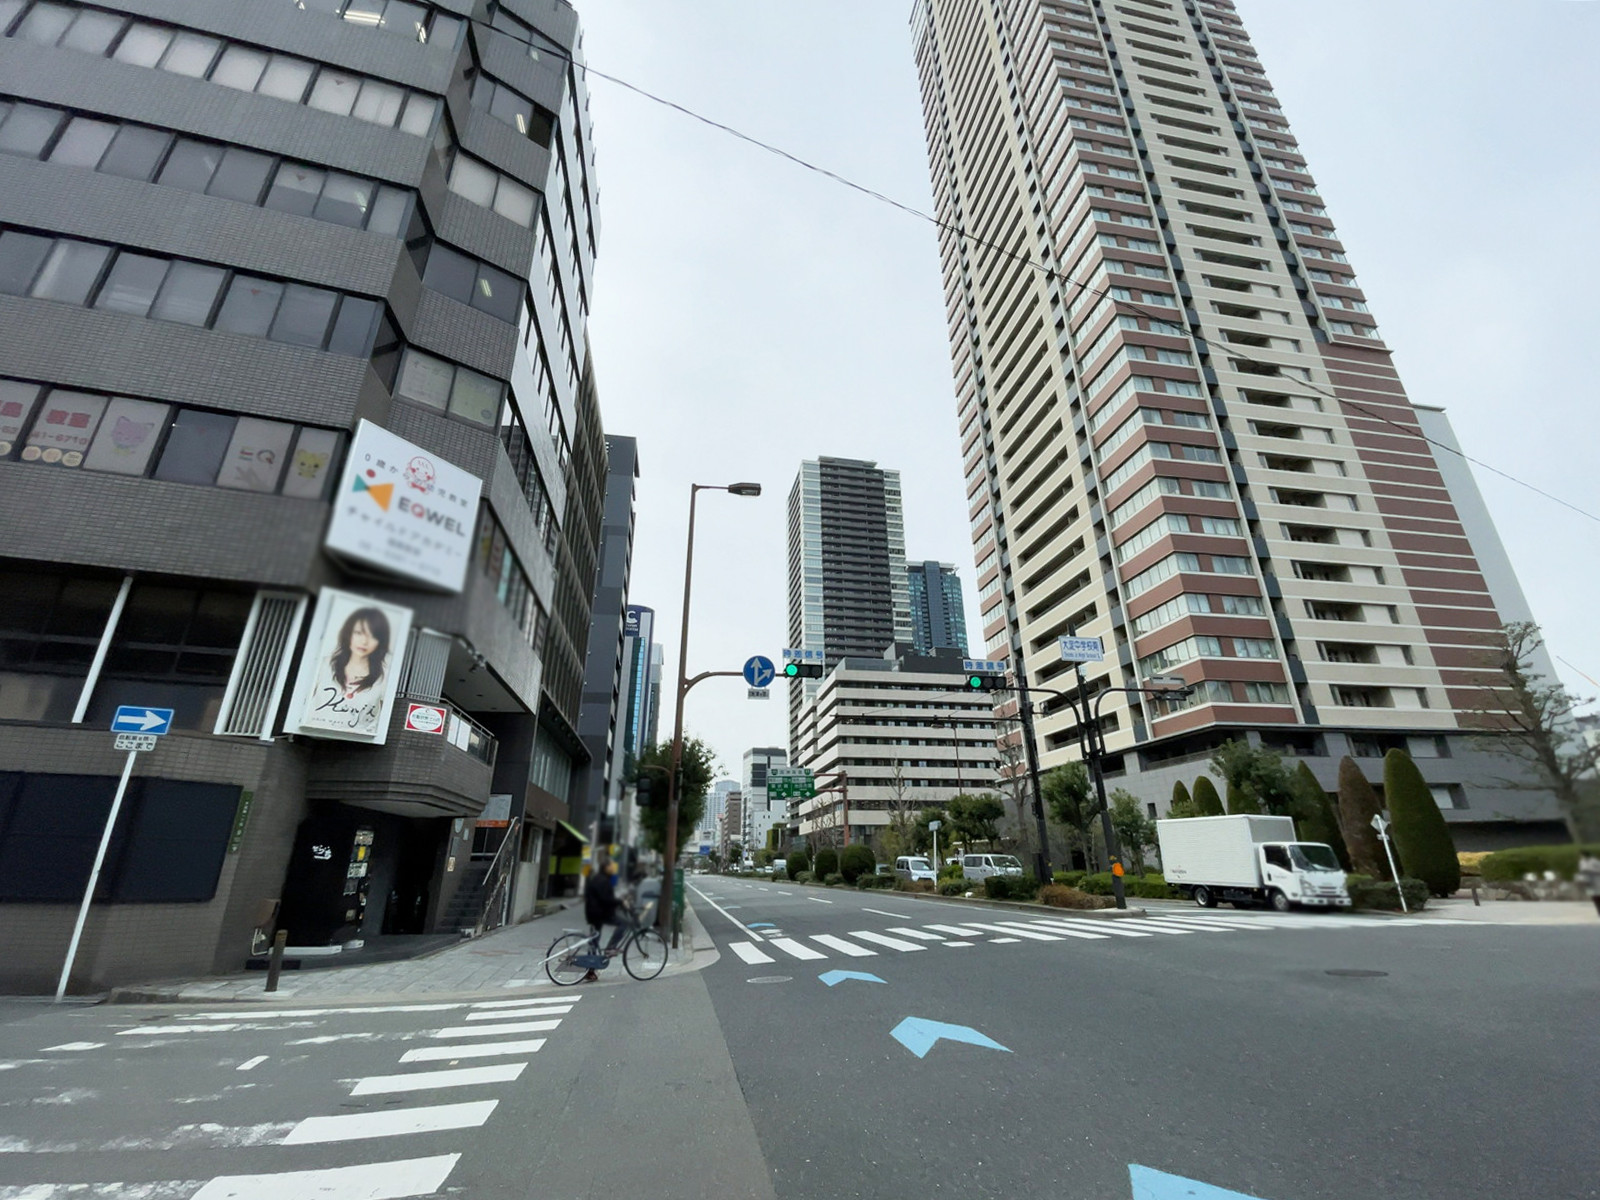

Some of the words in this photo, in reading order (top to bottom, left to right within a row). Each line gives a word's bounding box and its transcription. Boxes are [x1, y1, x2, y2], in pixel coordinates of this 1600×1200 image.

[397, 496, 466, 538] EQWEL
[116, 741, 154, 750] ここまで
